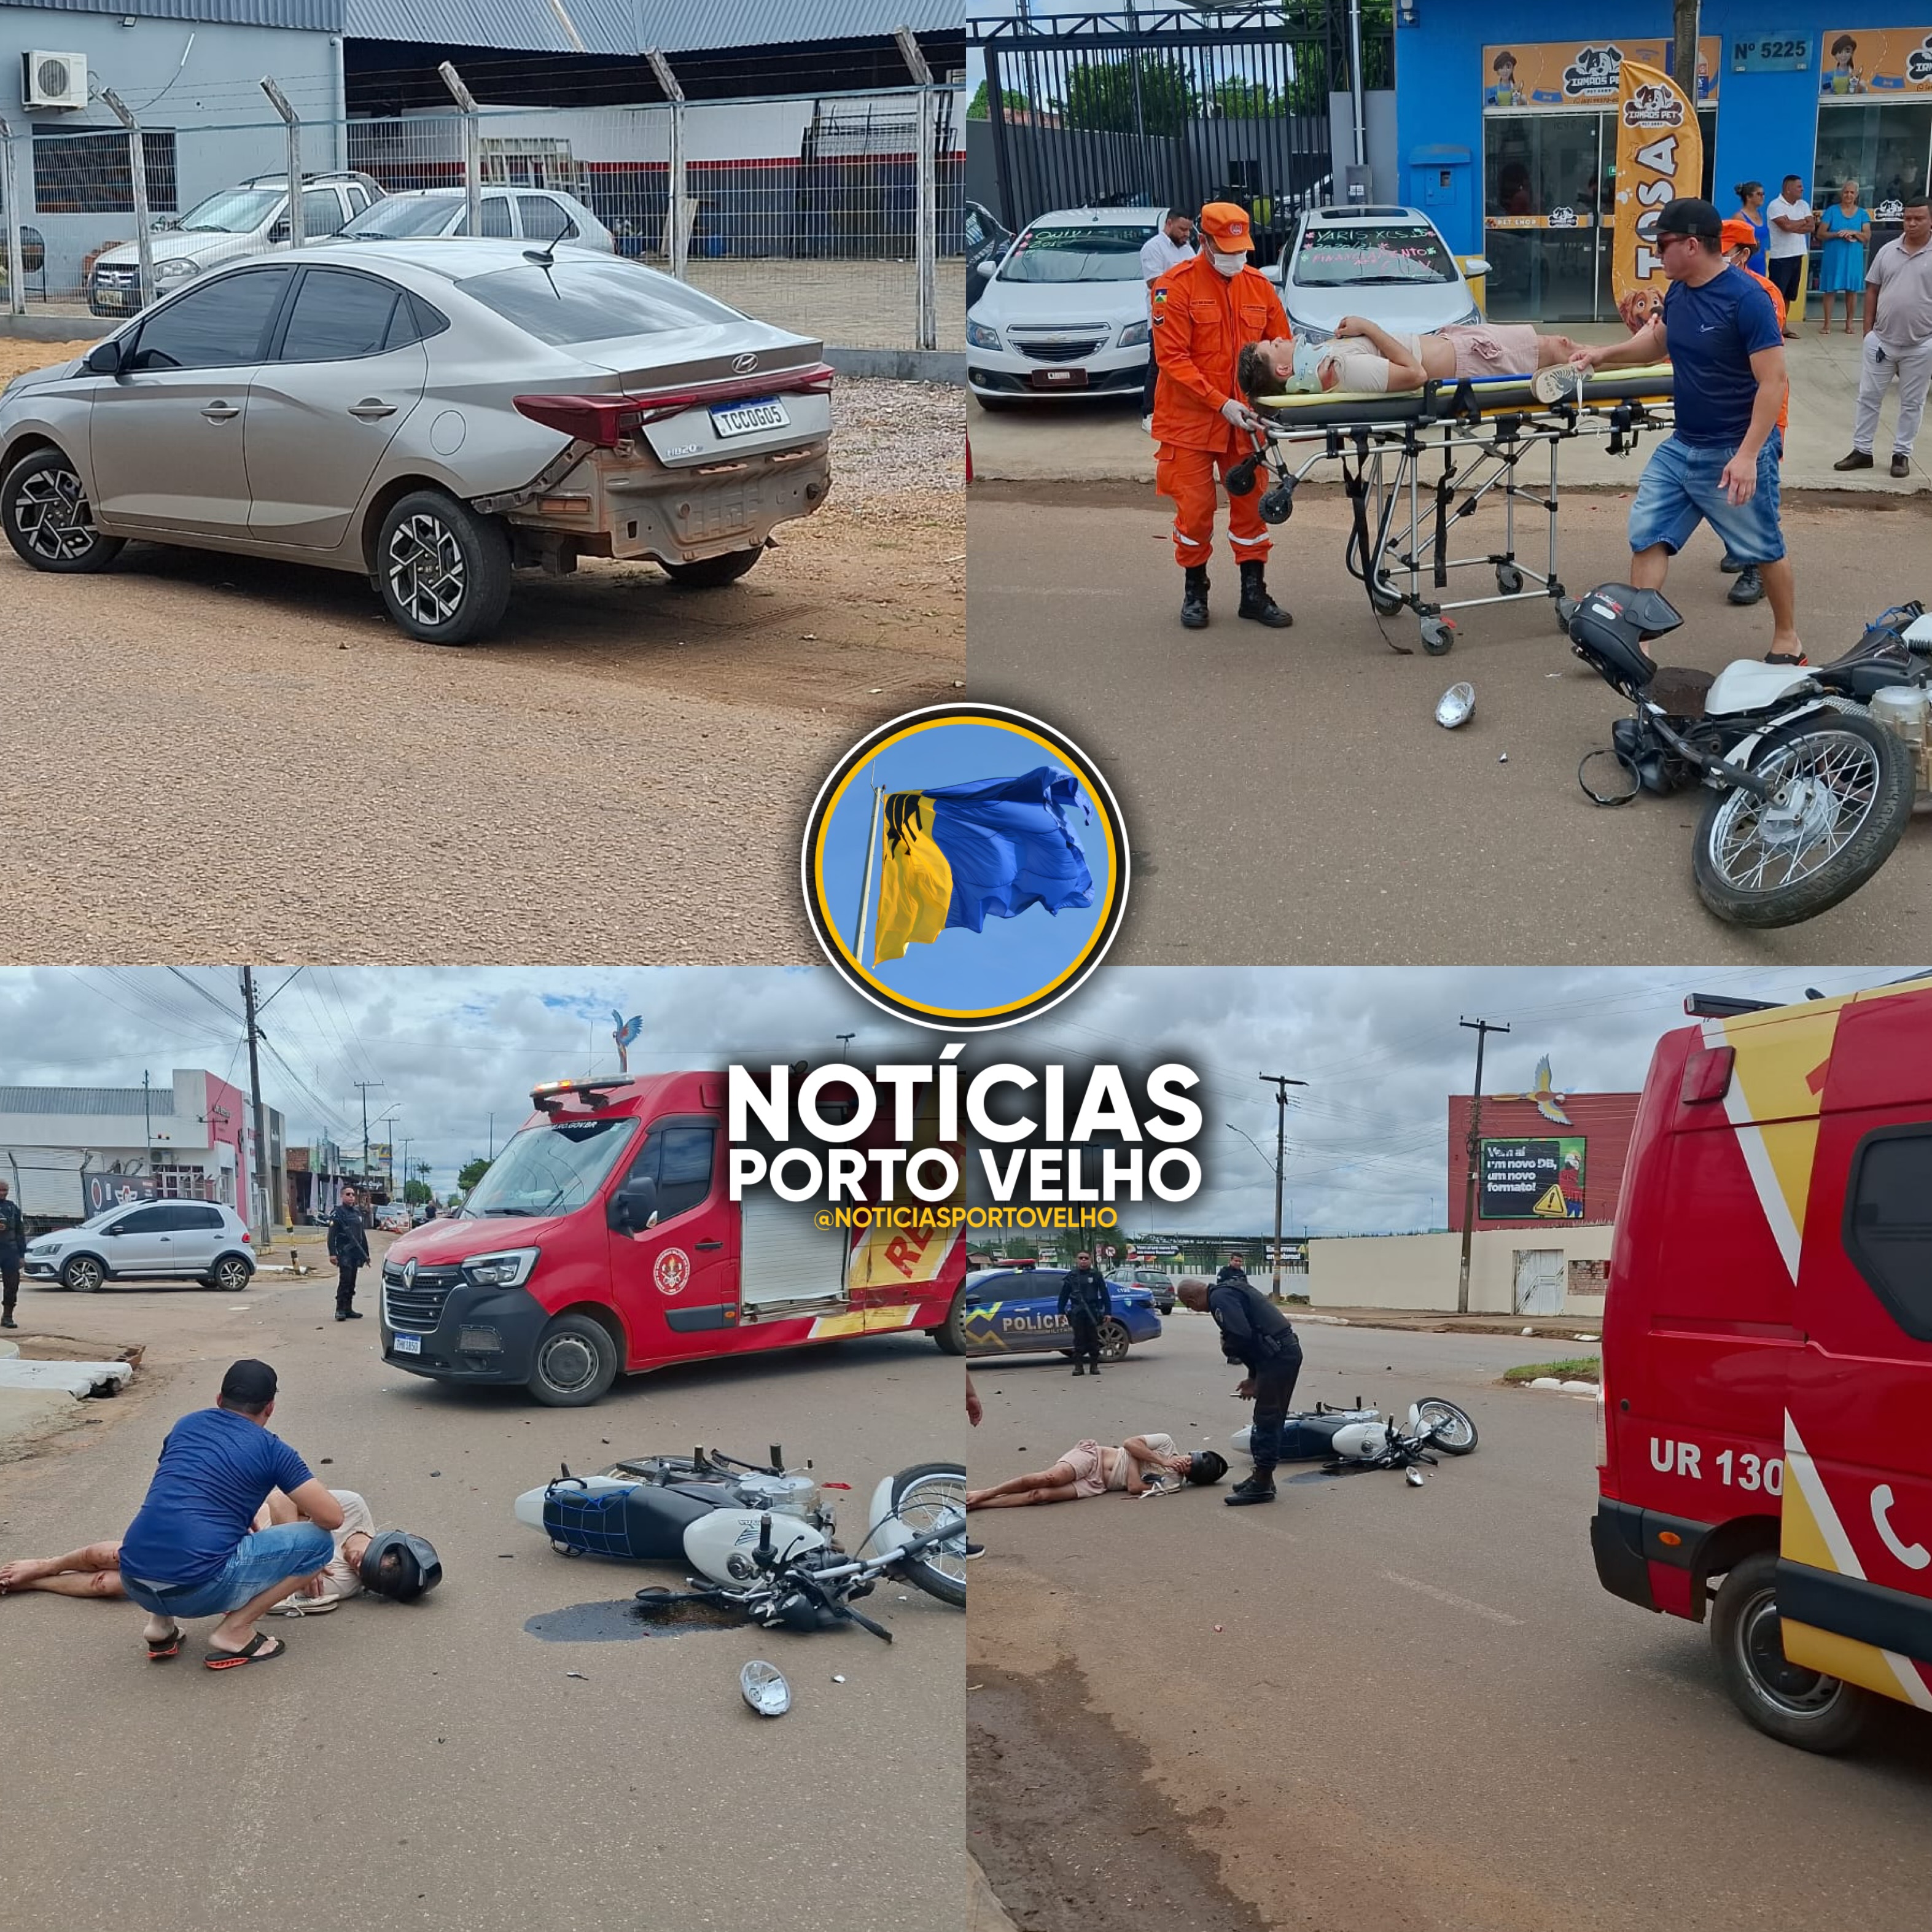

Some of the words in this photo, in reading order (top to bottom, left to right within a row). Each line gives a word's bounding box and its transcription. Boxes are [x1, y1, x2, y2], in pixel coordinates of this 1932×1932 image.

[1761, 41, 1806, 58] 5225
[1508, 1160, 1536, 1169] novo
[1508, 1172, 1536, 1180] novo
[1487, 1182, 1537, 1192] formato!
[1650, 1437, 1702, 1480] UR
[1716, 1449, 1783, 1496] 130
